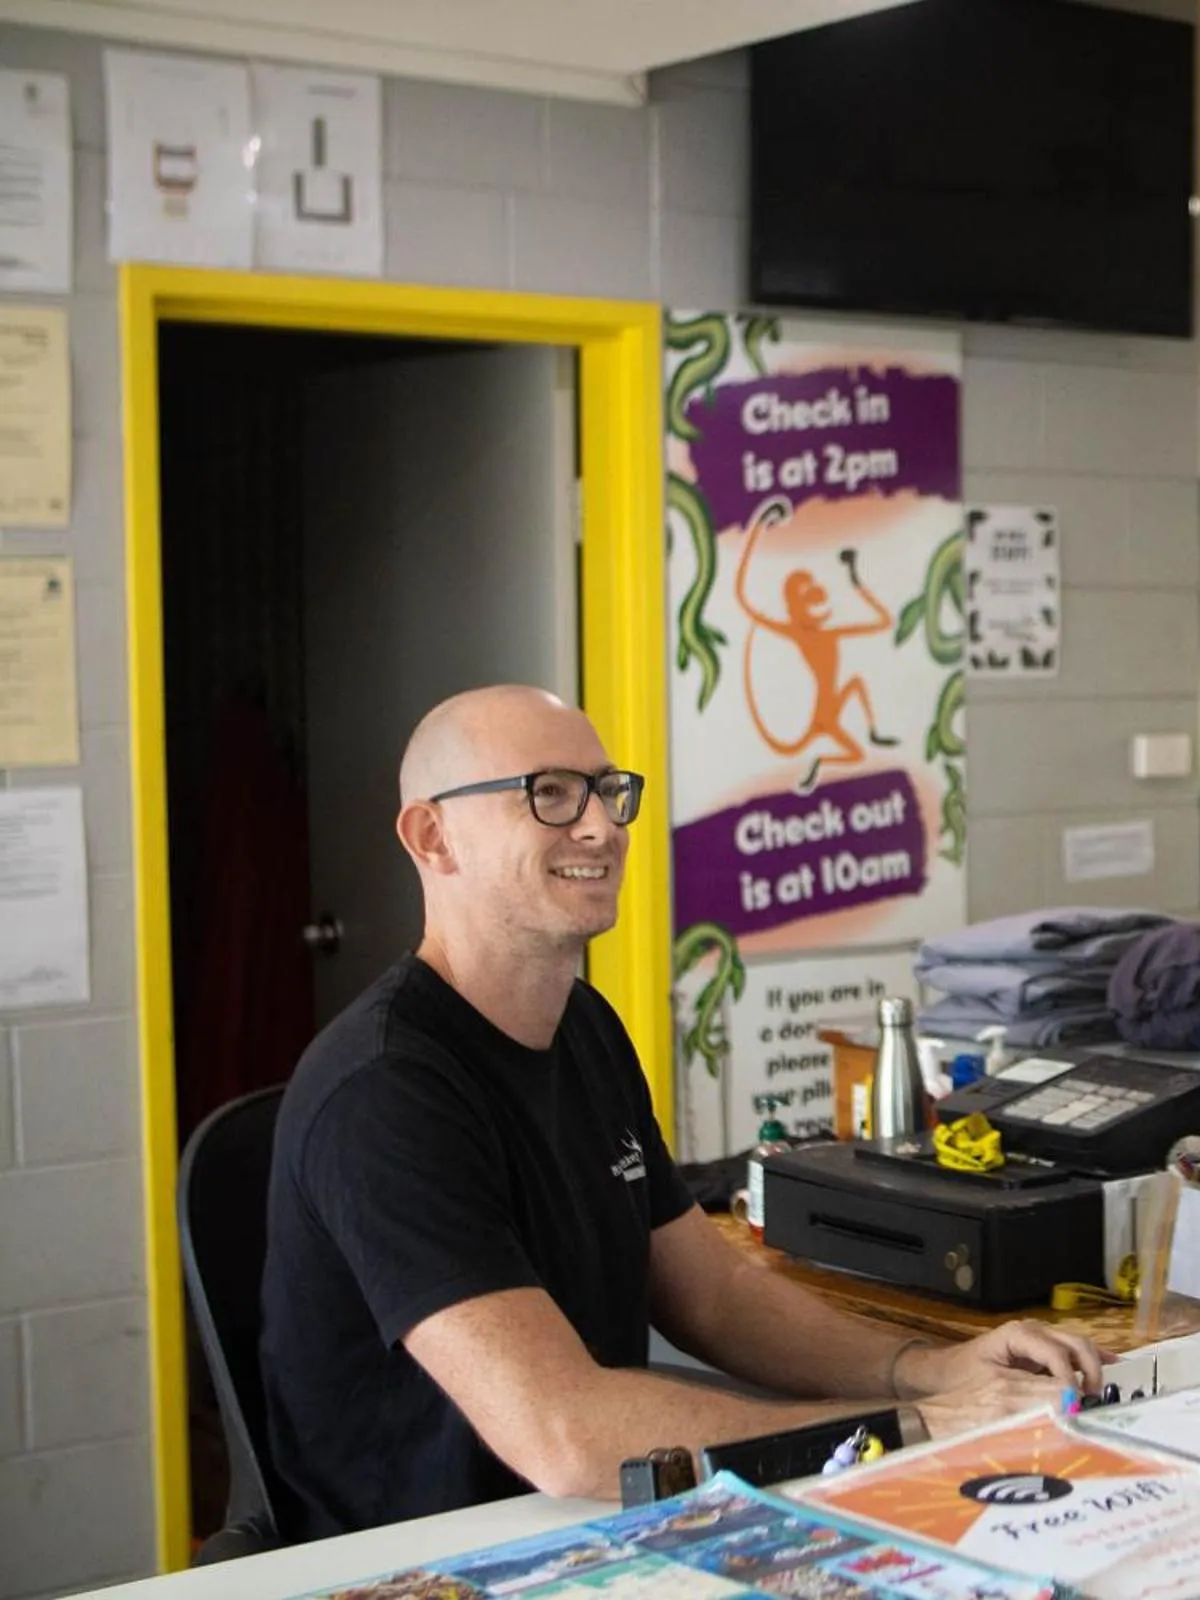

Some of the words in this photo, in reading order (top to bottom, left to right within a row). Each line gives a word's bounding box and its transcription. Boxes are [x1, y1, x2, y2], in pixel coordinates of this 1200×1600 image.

[743, 388, 851, 434] Check
[856, 385, 889, 424] in
[744, 451, 773, 491] is
[779, 450, 817, 487] at
[824, 443, 898, 491] 2pm
[735, 800, 844, 855] Check
[850, 791, 905, 831] out
[741, 871, 771, 911] is
[777, 863, 815, 903] at
[821, 851, 911, 895] 10am
[767, 987, 782, 1008] If
[788, 990, 823, 1012] you
[830, 985, 860, 1002] are
[867, 979, 884, 997] in
[779, 1020, 814, 1040] dor
[766, 1052, 829, 1077] please
